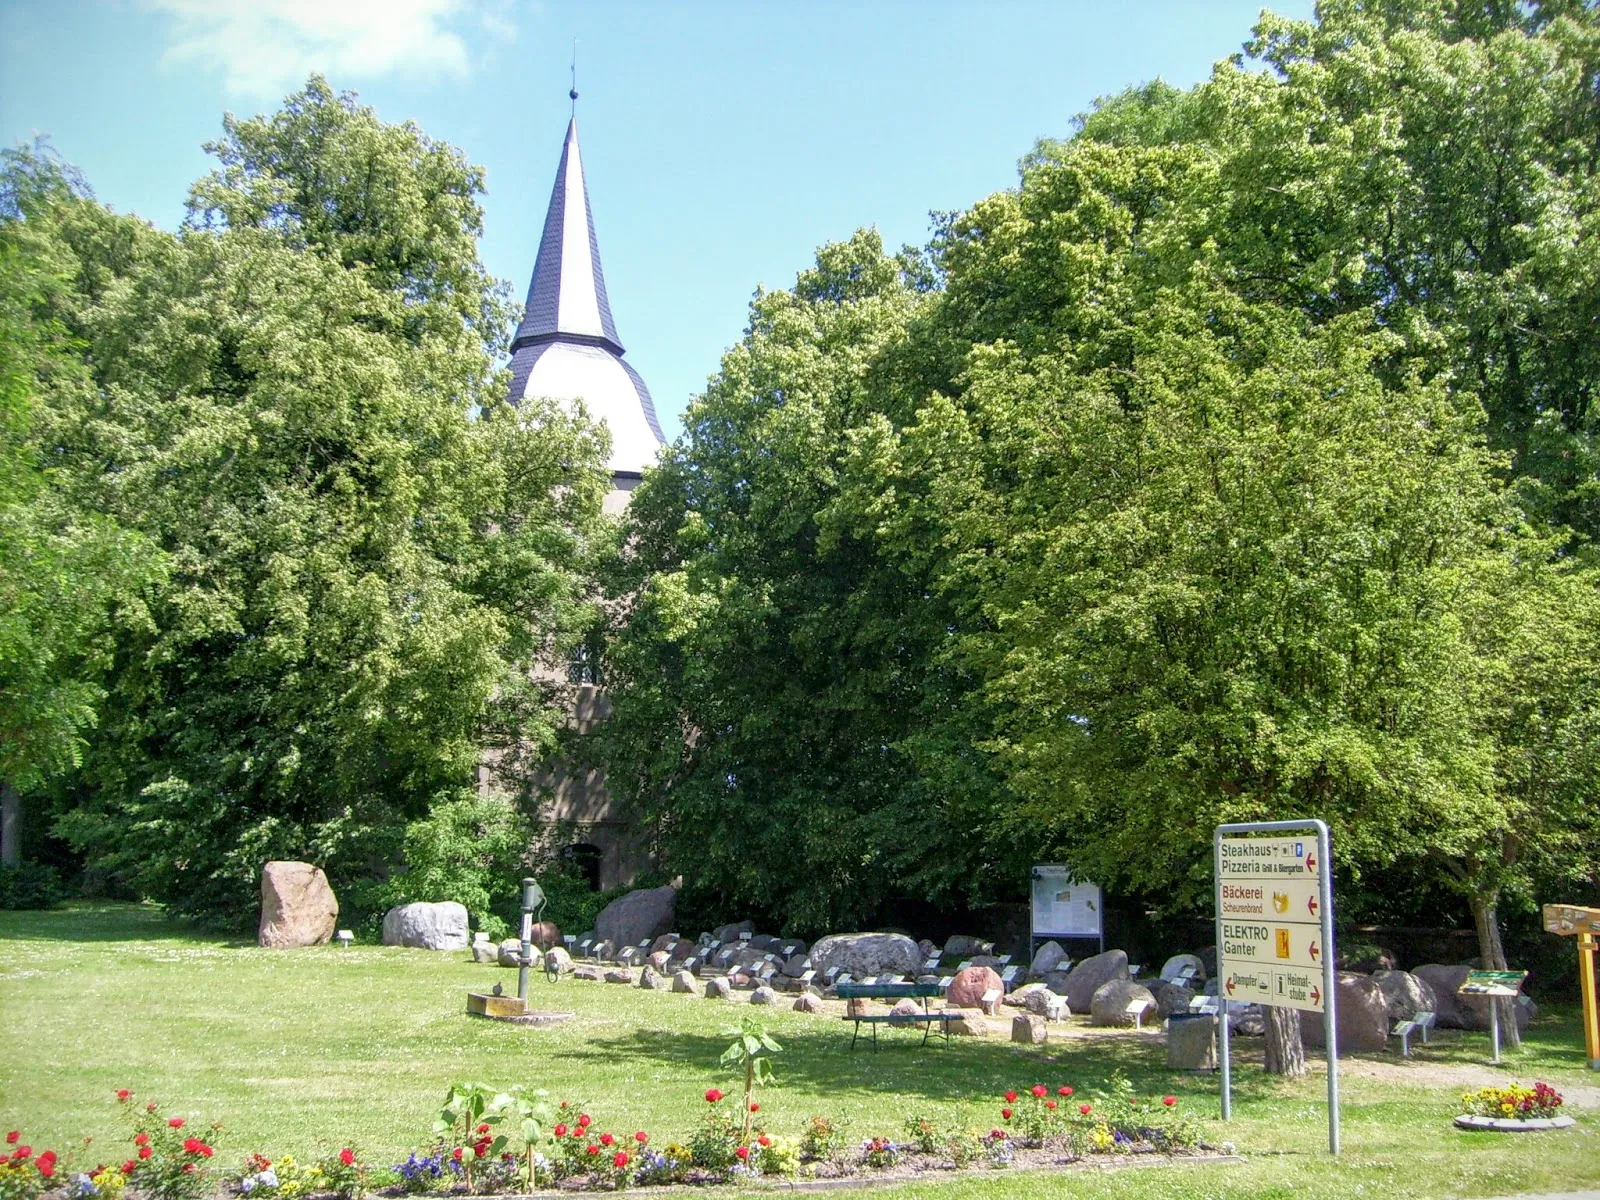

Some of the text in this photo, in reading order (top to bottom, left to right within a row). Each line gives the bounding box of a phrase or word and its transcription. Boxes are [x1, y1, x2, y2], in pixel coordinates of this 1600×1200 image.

[1221, 843, 1272, 857] Steakhaus
[1222, 860, 1260, 873] Pizzeria
[1222, 885, 1263, 899] Bäckerei
[1223, 925, 1269, 940] ELEKTRO
[1224, 941, 1256, 956] Ganter
[1289, 988, 1307, 1001] stube
